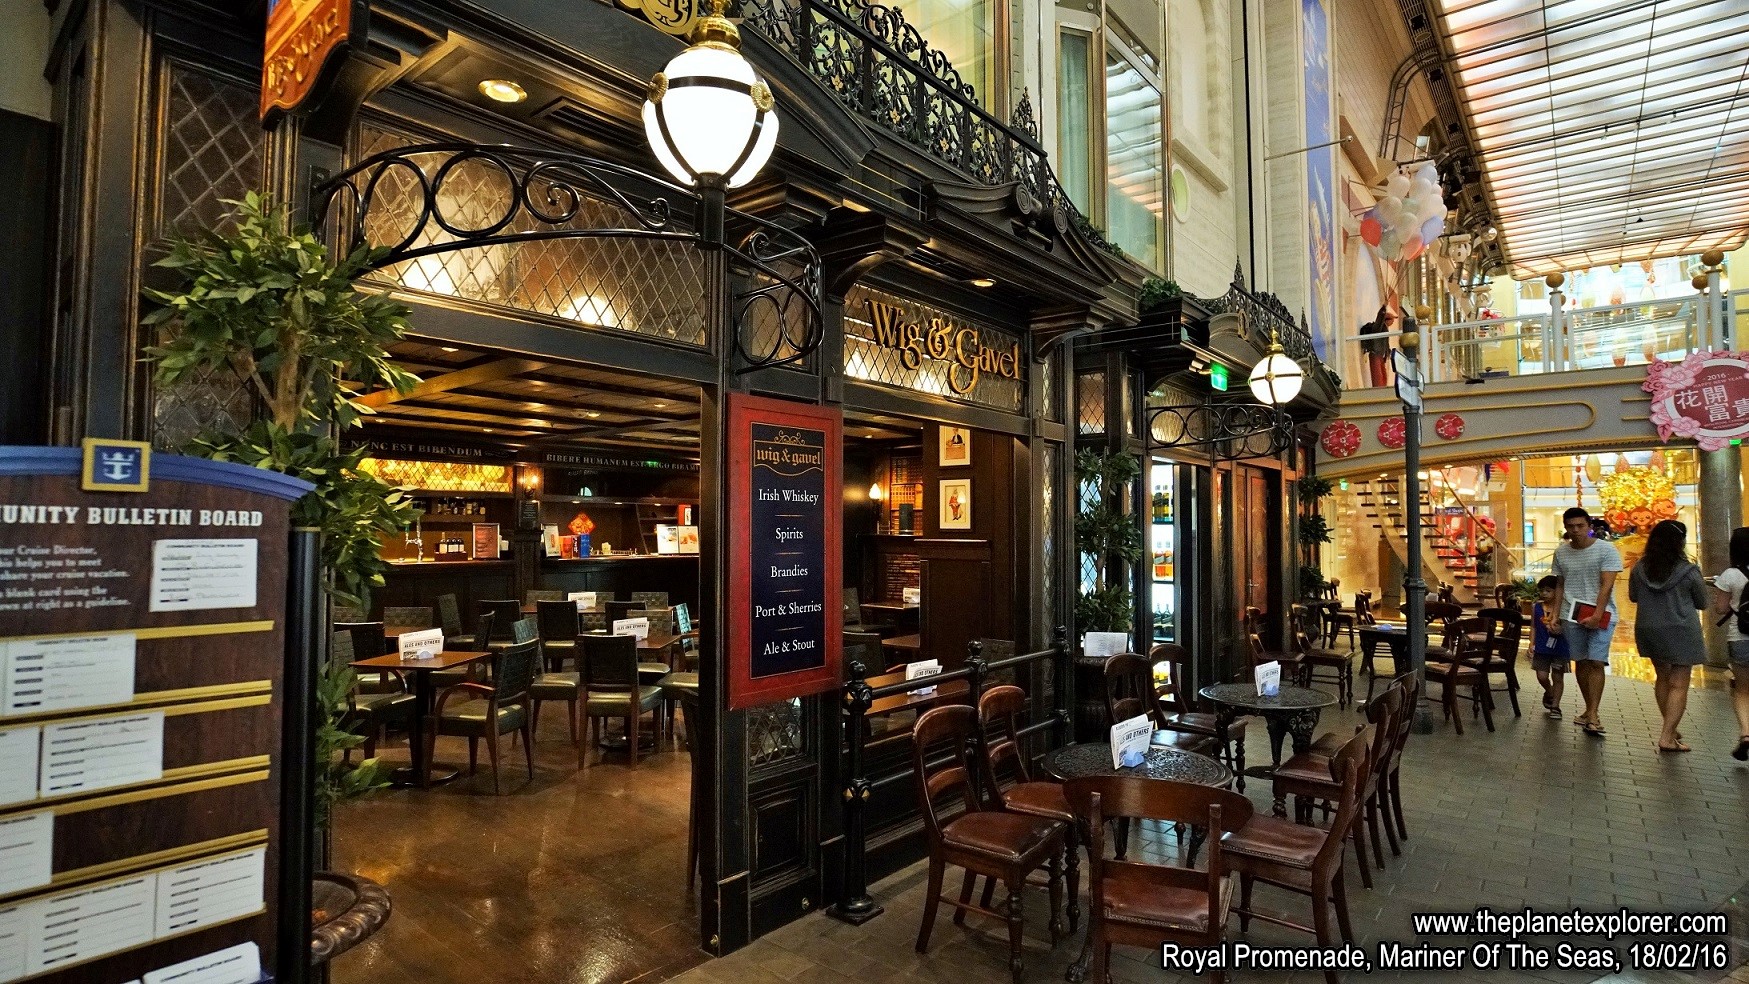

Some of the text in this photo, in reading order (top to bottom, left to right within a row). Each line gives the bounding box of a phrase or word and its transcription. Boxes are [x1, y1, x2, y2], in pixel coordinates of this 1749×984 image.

[864, 298, 1020, 395] Wig & Gavel
[1707, 373, 1726, 381] 2016
[1674, 384, 1729, 410] 花開
[351, 440, 482, 457] NNC EST BIBENDUM
[757, 447, 821, 467] wig & gavel
[546, 453, 581, 463] BIBERE
[583, 456, 629, 467] HUMANUM
[758, 488, 819, 506] Irish Whiskey
[0, 504, 263, 527] UNITY BULLETIN BOARD
[775, 527, 804, 543] Spirits
[770, 564, 809, 578] Brandies
[755, 600, 822, 618] Port & Sherries
[763, 639, 815, 655] Ale & Stout
